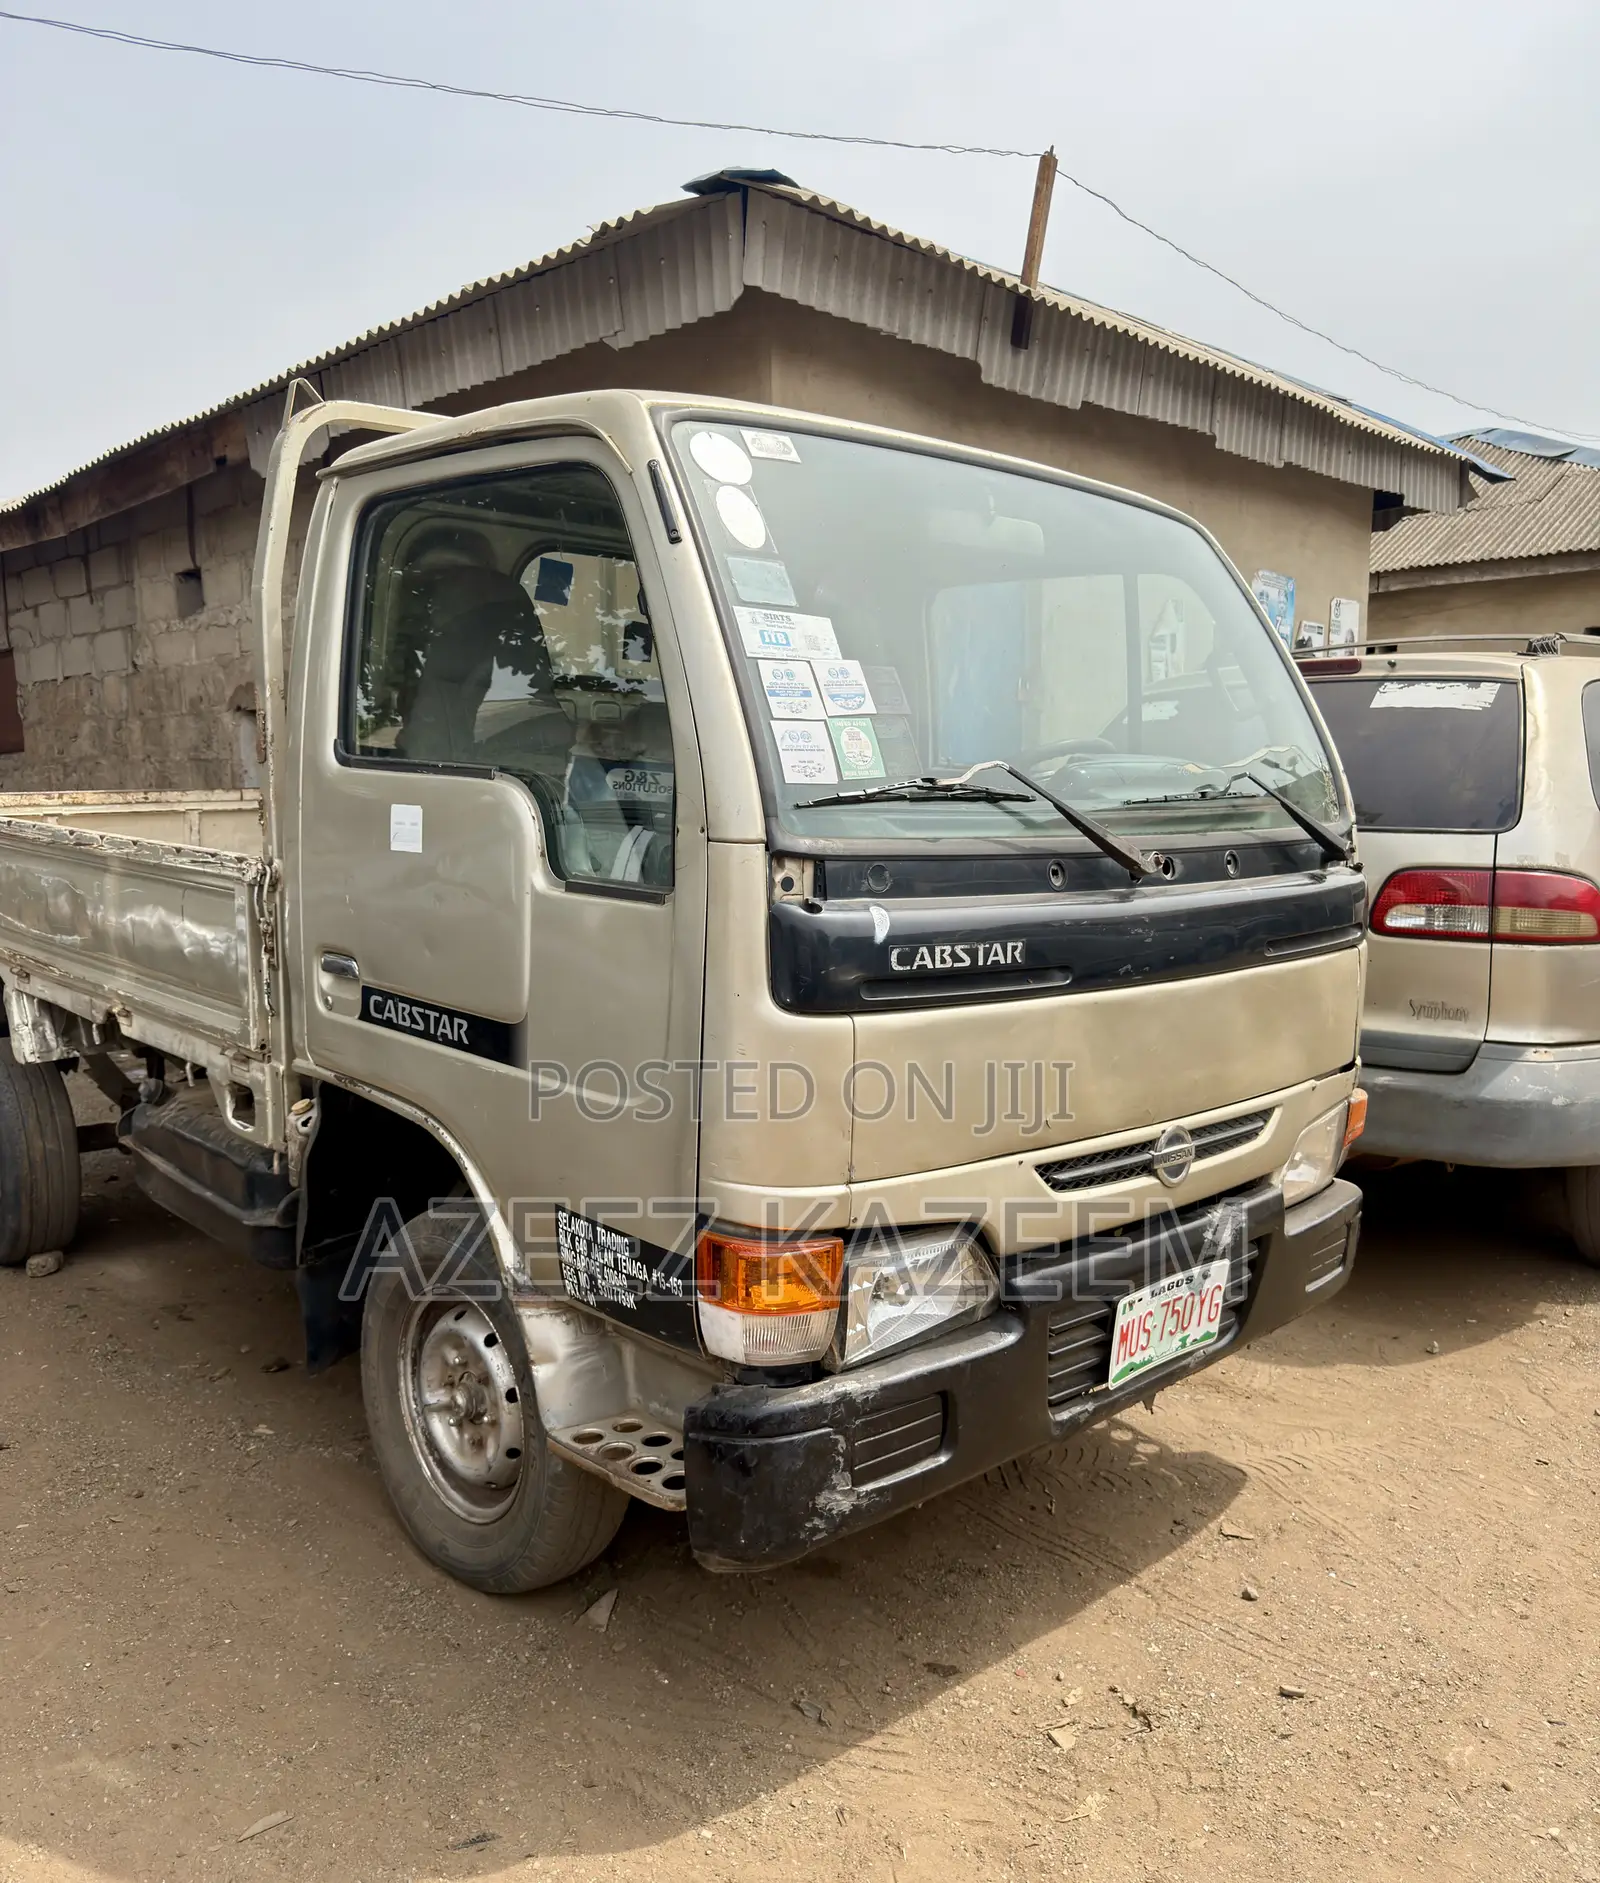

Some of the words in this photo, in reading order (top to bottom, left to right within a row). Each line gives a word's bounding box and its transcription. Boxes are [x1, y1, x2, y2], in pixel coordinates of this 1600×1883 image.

[890, 941, 1023, 971] CABSTAR
[369, 994, 469, 1045] CABSTAR
[1160, 1148, 1192, 1164] NISSAN
[558, 1211, 593, 1241] SELAKOTA
[597, 1227, 629, 1256] TRADING
[559, 1228, 572, 1249] BLK
[591, 1243, 614, 1267] JALAN
[617, 1254, 649, 1282] TENAGA
[560, 1246, 601, 1279] SINGAPORE
[1150, 1275, 1194, 1299] LAGOS
